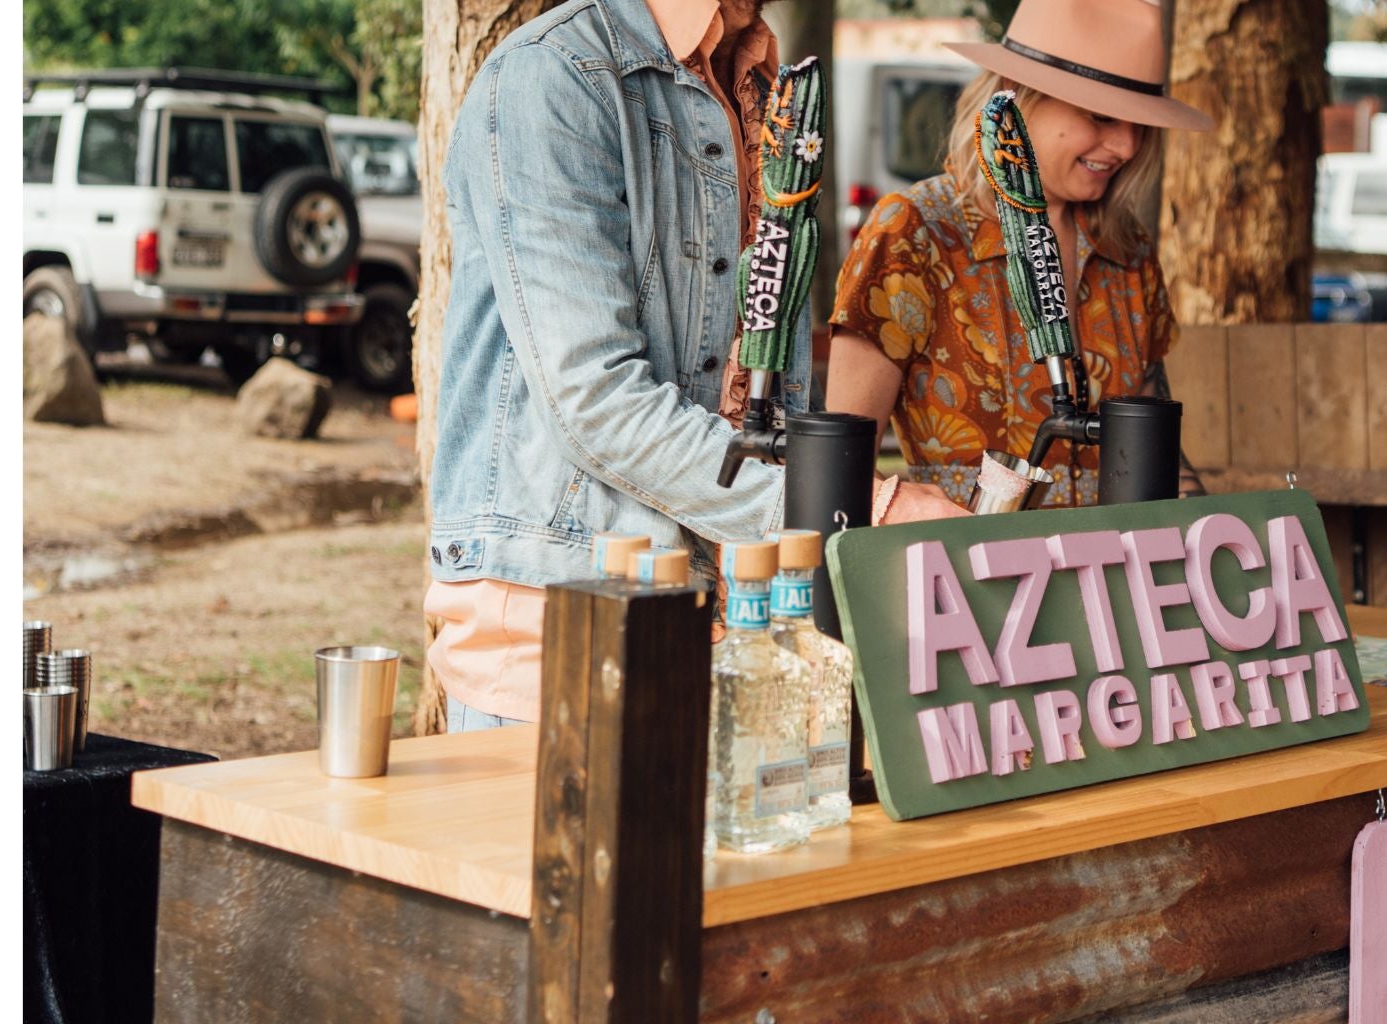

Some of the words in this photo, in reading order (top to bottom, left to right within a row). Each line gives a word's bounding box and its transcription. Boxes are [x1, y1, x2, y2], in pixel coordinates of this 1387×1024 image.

[752, 221, 789, 331] AZTECA
[1025, 225, 1056, 323] MARGARITA
[1040, 225, 1070, 320] AZTECA
[906, 513, 1348, 695] AZTECA
[917, 648, 1360, 784] MARGARITA
